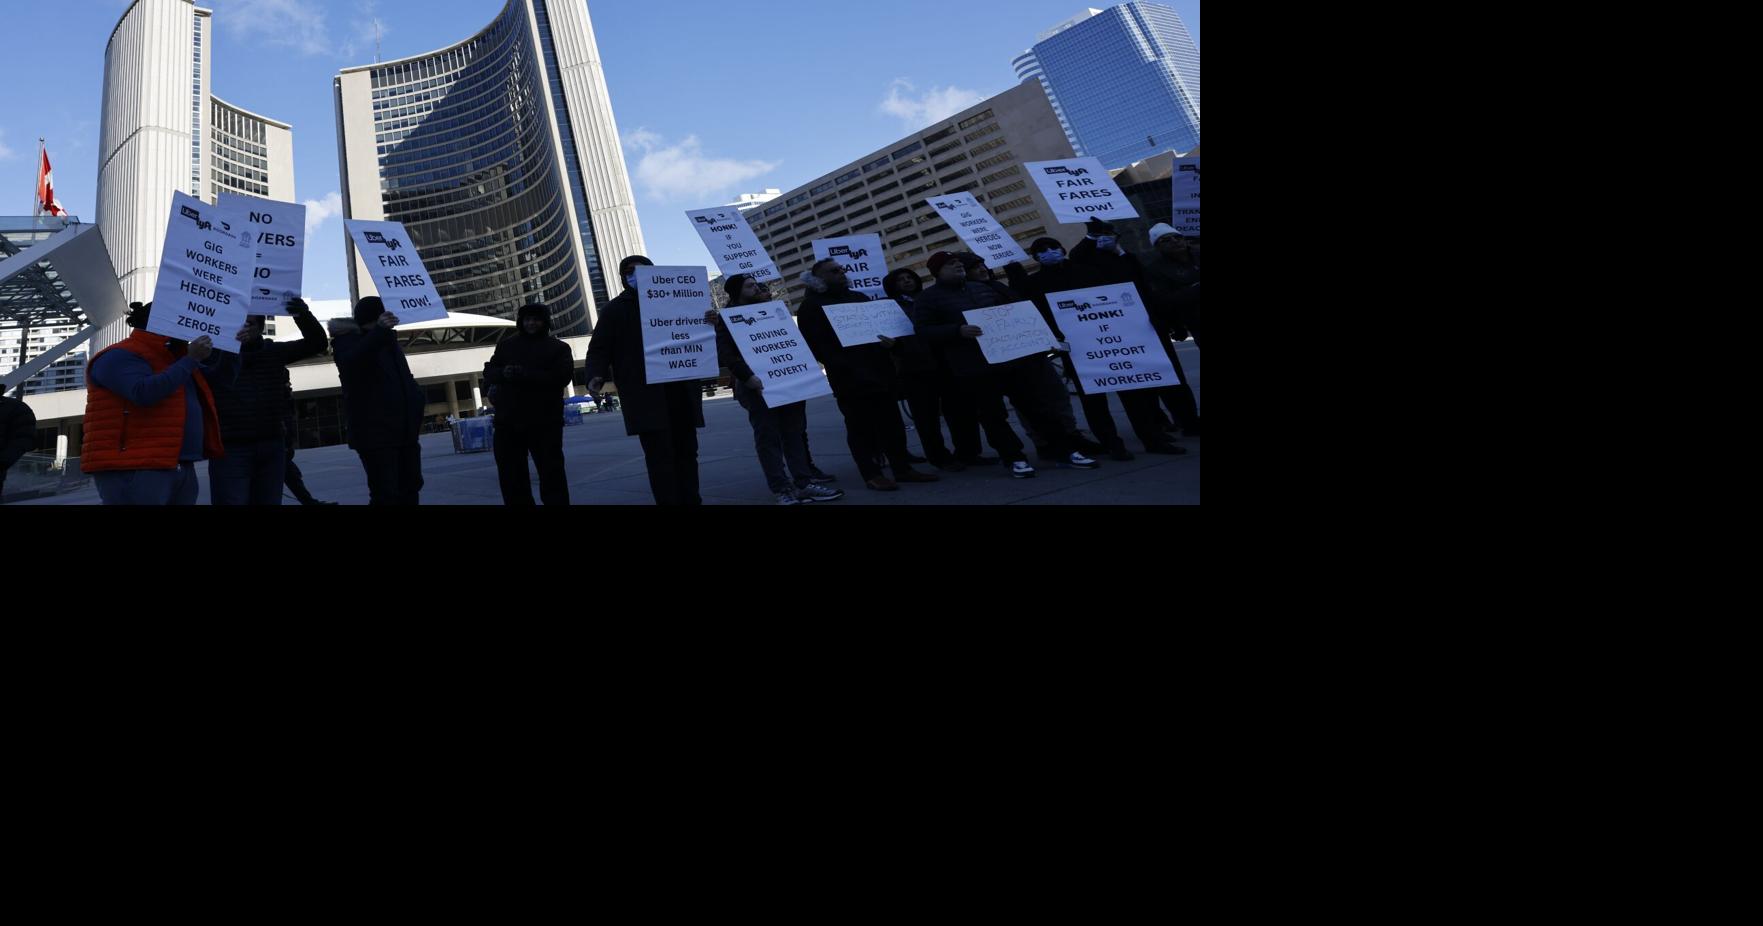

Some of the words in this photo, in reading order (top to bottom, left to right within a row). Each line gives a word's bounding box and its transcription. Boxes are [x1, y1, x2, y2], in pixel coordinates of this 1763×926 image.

[1067, 168, 1088, 177] lyft
[1056, 178, 1094, 188] FAIR
[1059, 189, 1112, 200] FARES
[1074, 202, 1114, 213] now!
[181, 205, 199, 220] Uber
[196, 218, 212, 231] lyft
[249, 211, 273, 225] NO
[960, 218, 988, 227] WORKERS
[710, 223, 738, 233] HONK!
[364, 232, 385, 242] Uber
[384, 238, 401, 250] lyft
[975, 233, 1001, 244] HEROES
[204, 241, 223, 255] GIG
[829, 246, 848, 256] Uber
[848, 248, 868, 260] lyft
[723, 249, 757, 261] SUPPORT
[992, 250, 1014, 260] ZEROES
[186, 249, 238, 275] WORKERS
[378, 255, 409, 267] FAIR
[738, 261, 753, 270] GIG
[192, 267, 223, 285] WERE
[751, 268, 771, 278] KERS
[384, 274, 425, 288] FARES
[651, 275, 675, 285] Uber
[676, 275, 696, 284] CEO
[850, 277, 881, 289] RES
[180, 280, 231, 305] HEROES
[646, 289, 670, 299] $30+
[672, 289, 704, 298] Million
[400, 295, 432, 309] now!
[1074, 302, 1092, 312] lyft
[188, 301, 216, 317] NOW
[1077, 309, 1124, 322] HONK!
[177, 315, 221, 336] ZEROES
[649, 318, 673, 327] Uber
[675, 317, 707, 326] drivers
[1099, 324, 1110, 332] IF
[671, 331, 690, 340] less
[749, 328, 788, 342] DRIVING
[1096, 335, 1122, 345] YOU
[660, 345, 682, 355] than
[684, 344, 703, 353] MIN
[752, 339, 798, 354] WORKERS
[1086, 345, 1146, 360] SUPPORT
[668, 358, 698, 369] WAGE
[770, 353, 793, 364] INTO
[767, 363, 808, 379] POVERTY
[1109, 361, 1133, 371] GIG
[1094, 372, 1162, 387] WORKERS
